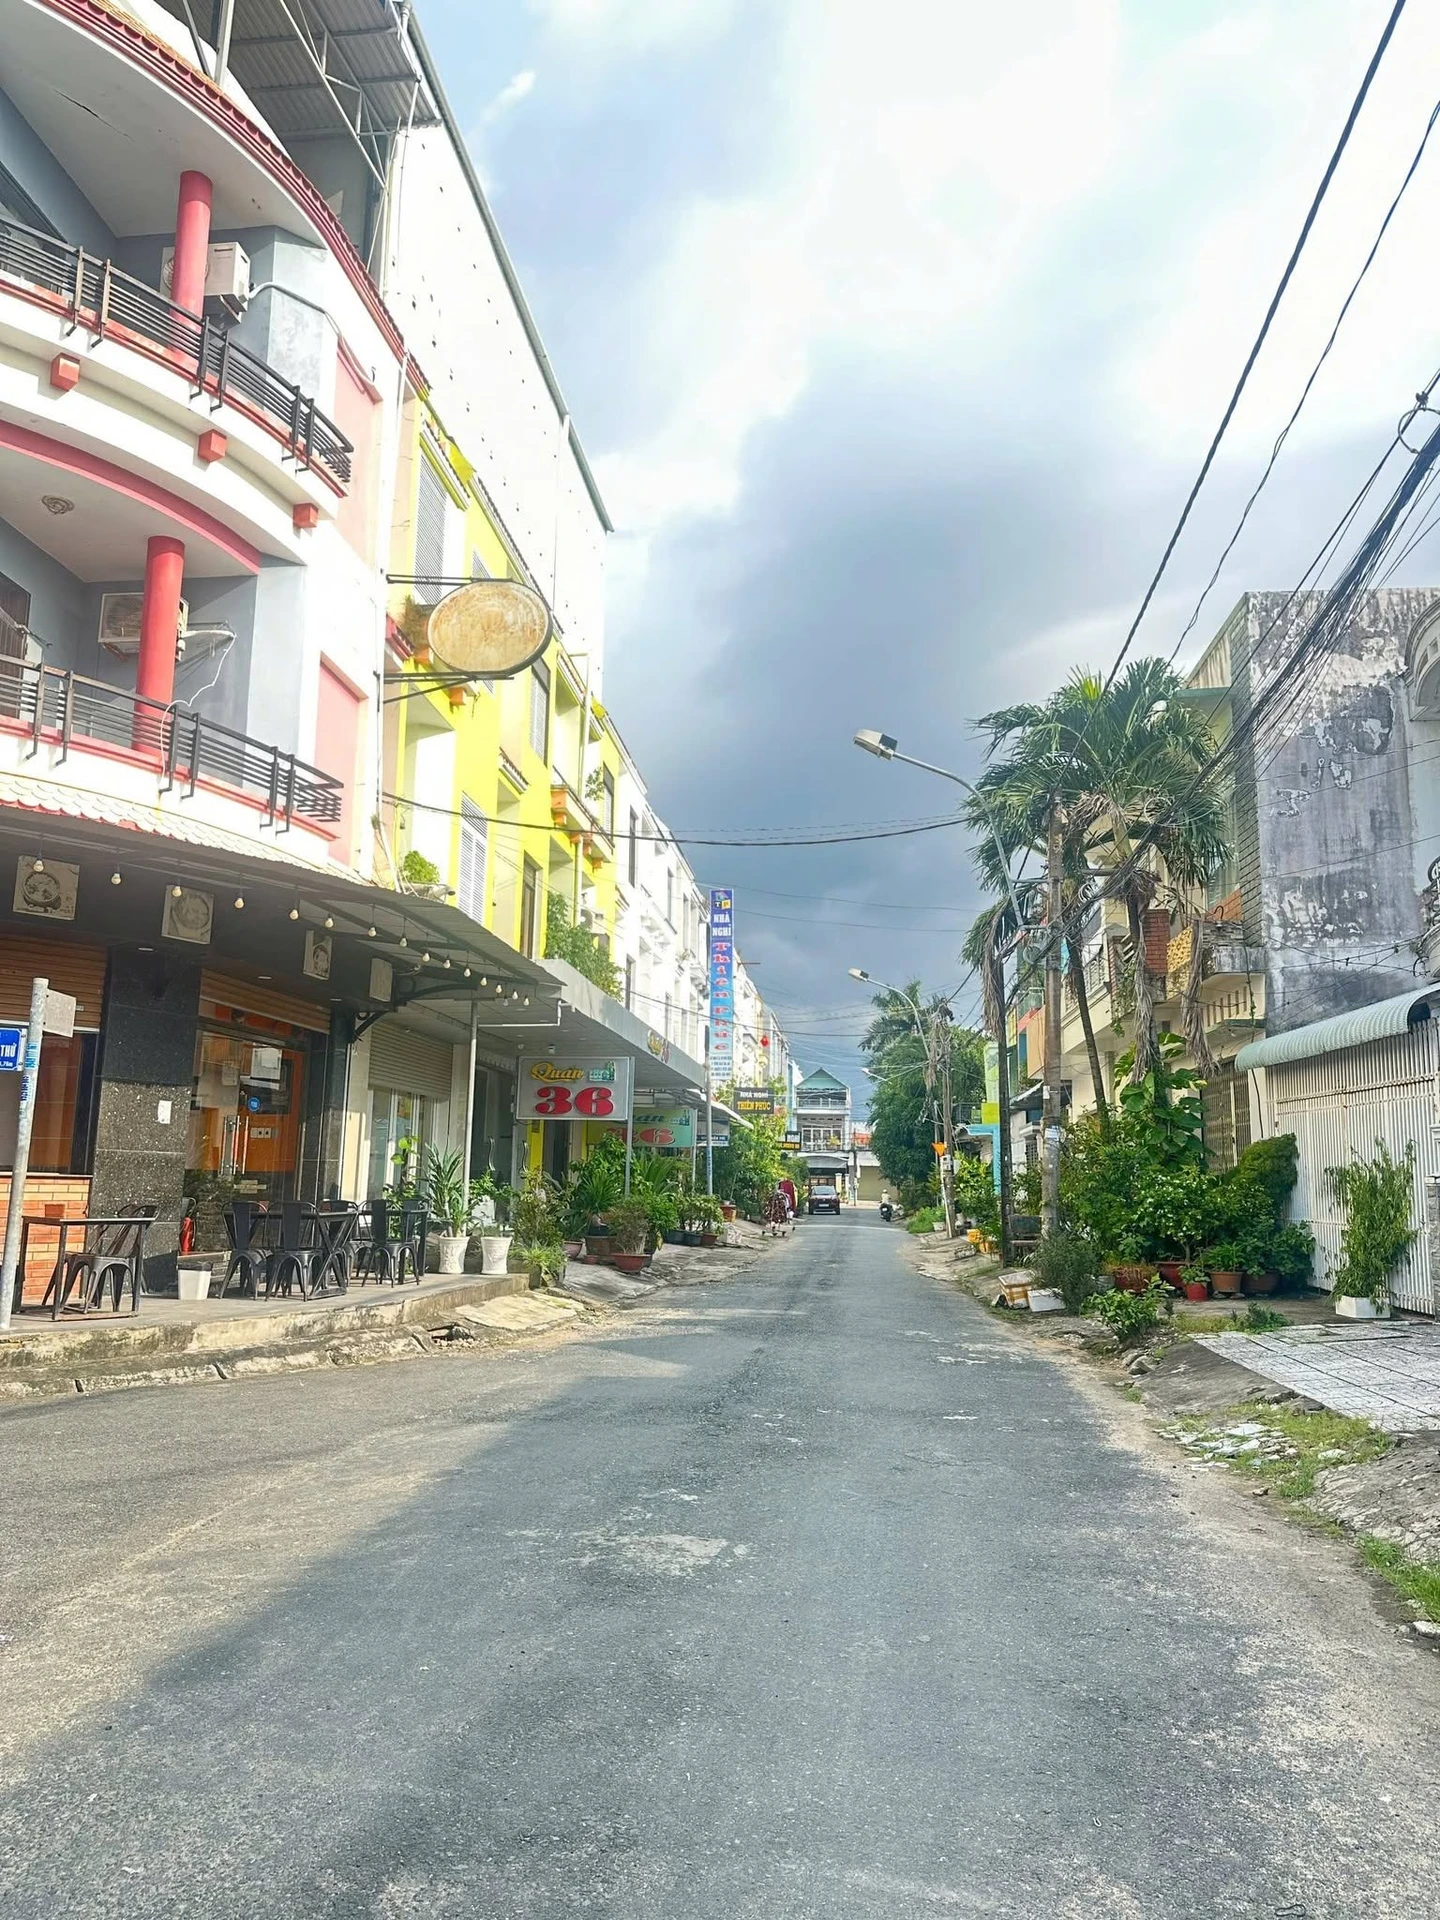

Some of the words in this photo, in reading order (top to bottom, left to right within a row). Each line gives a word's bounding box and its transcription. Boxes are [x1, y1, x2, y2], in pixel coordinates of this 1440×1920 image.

[713, 911, 731, 923] NHÀ
[712, 923, 732, 937] NGHỈ
[535, 1086, 615, 1116] 36
